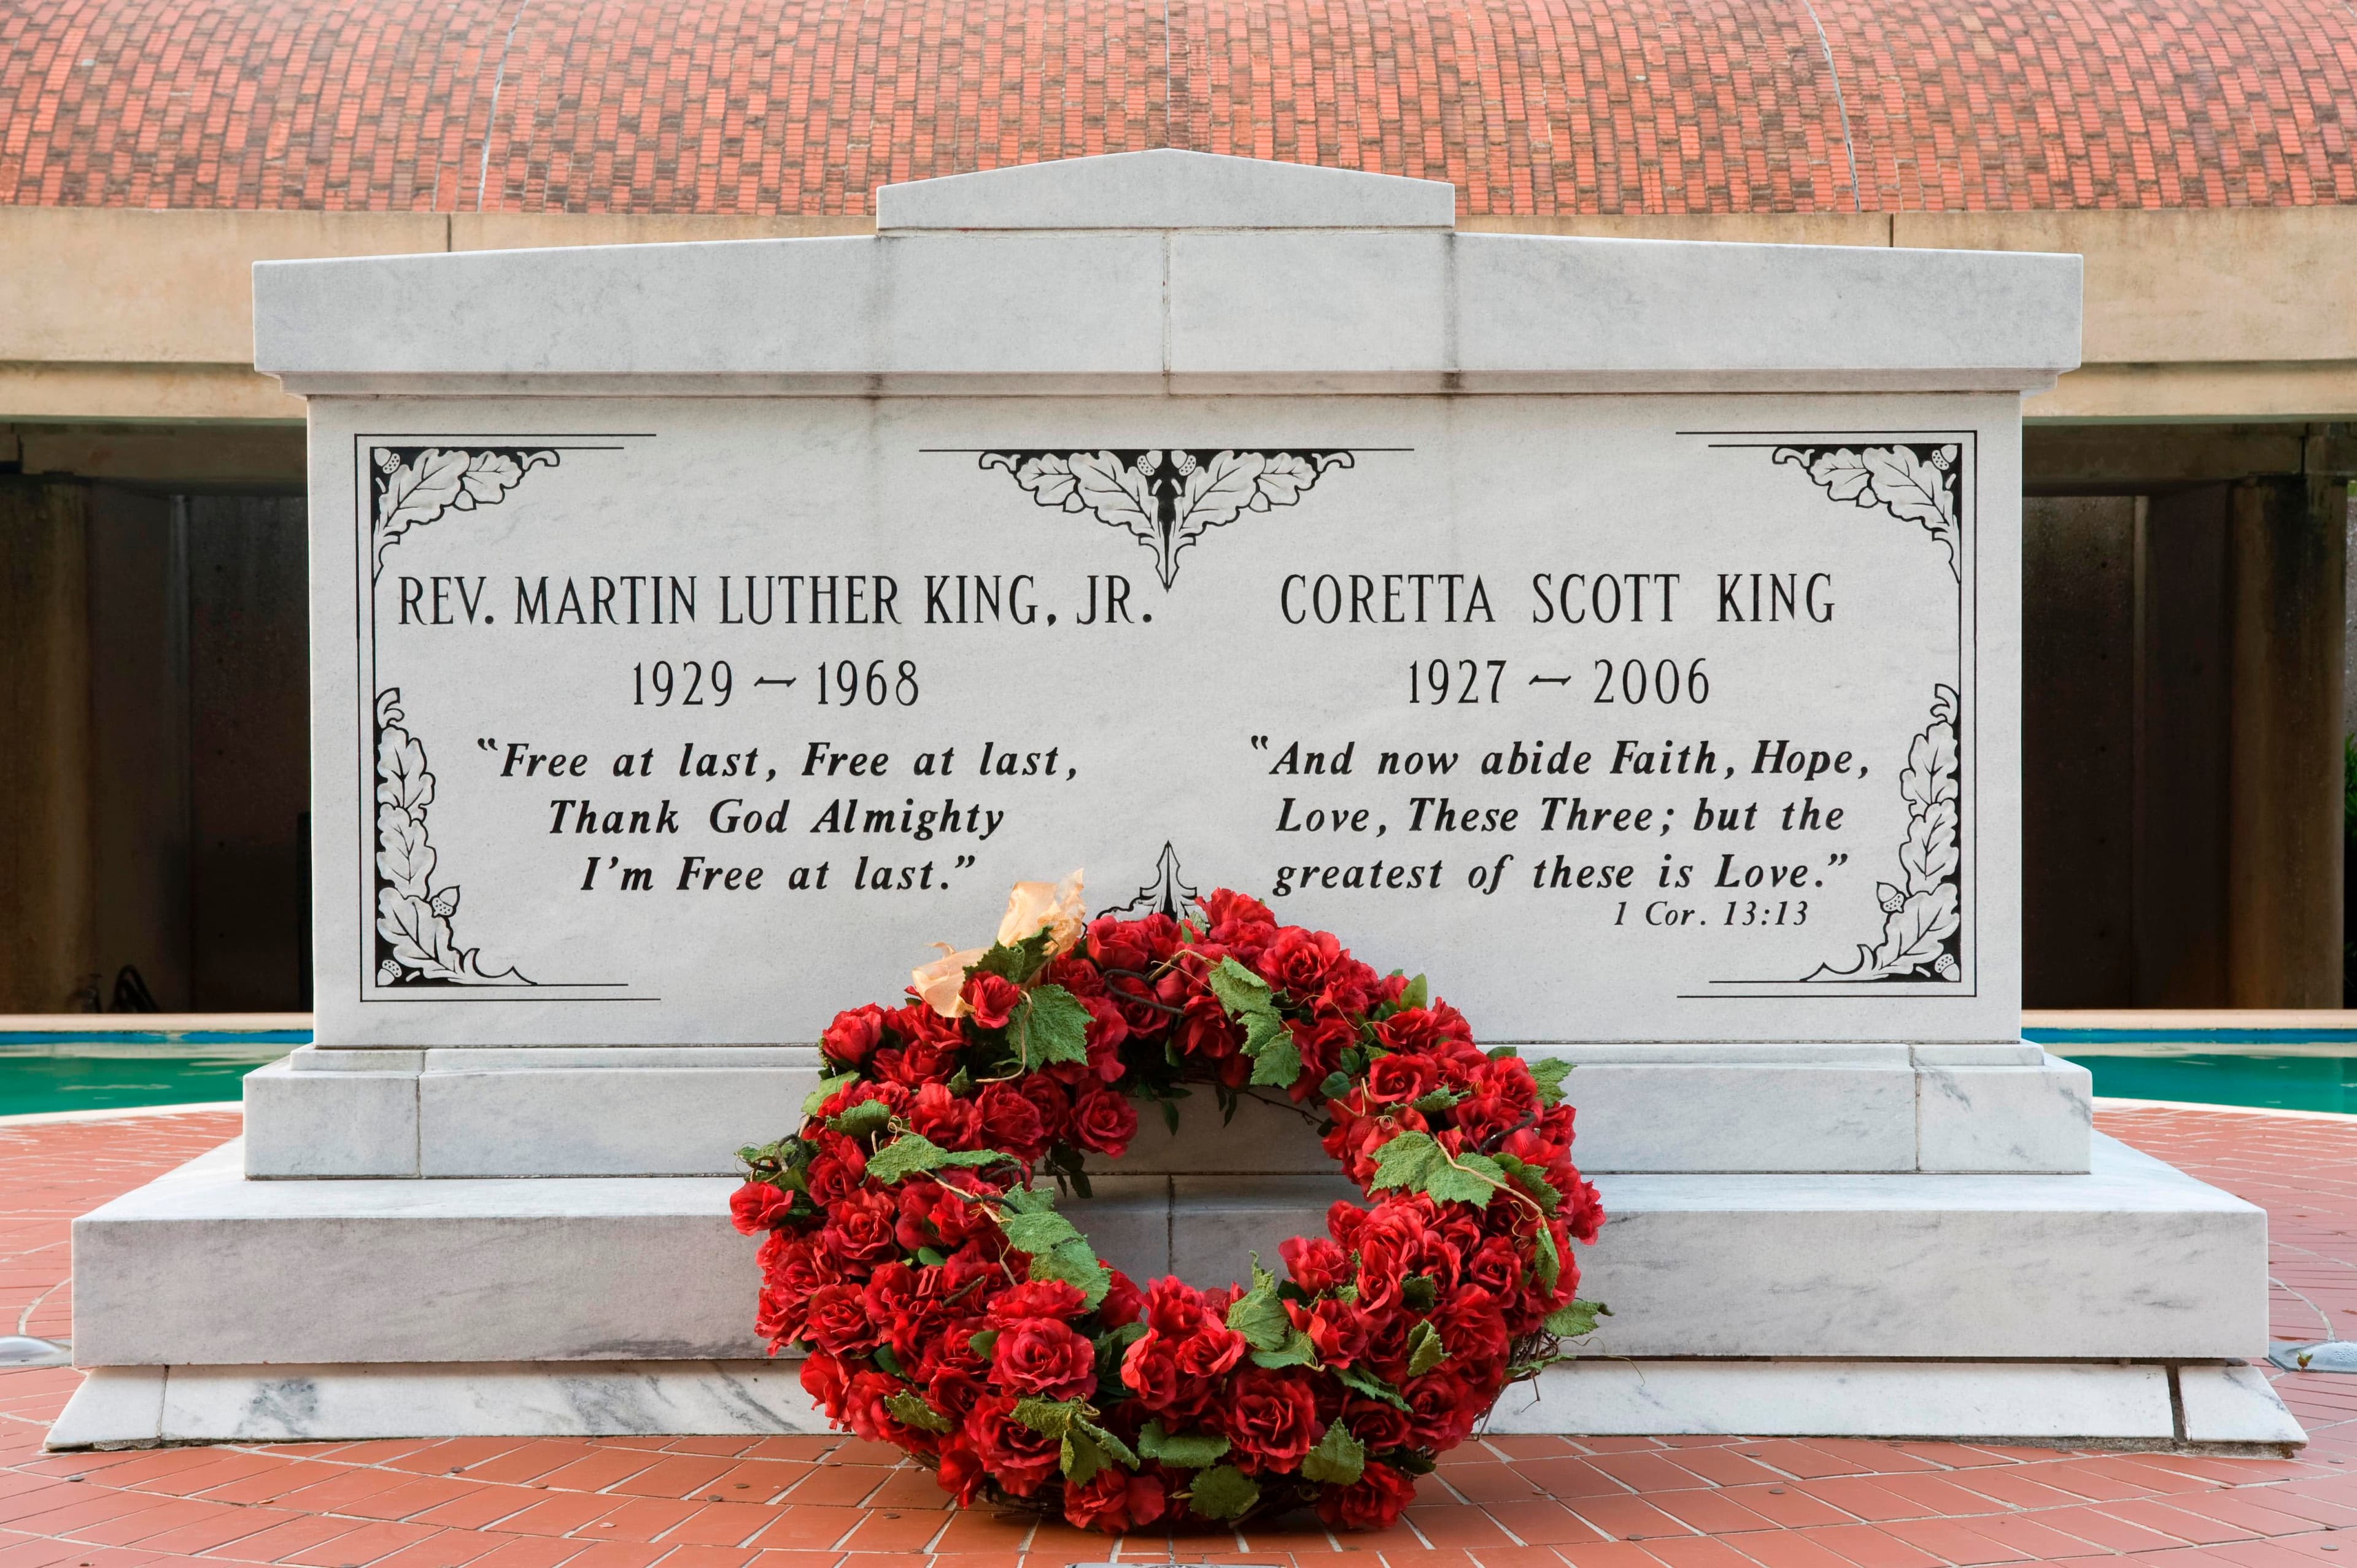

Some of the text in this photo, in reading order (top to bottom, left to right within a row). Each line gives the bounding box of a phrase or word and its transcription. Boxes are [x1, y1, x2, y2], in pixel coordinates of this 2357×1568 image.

[398, 574, 1152, 627] REV. MARTIN LUTHER KING, JR.
[1281, 573, 1835, 625] CORETTA SCOTT KING
[633, 660, 732, 707] 1929
[818, 659, 919, 707] 1968
[1409, 658, 1507, 705] 1927
[1593, 657, 1709, 705] 2006
[477, 738, 1077, 782] “Free at last, Free at last,
[1251, 735, 1868, 781] “And now abide Faith, Hope,
[549, 798, 1004, 841] Thank God Almighty
[1275, 797, 1844, 838] Love, These Three; but the
[580, 855, 975, 891] I’m Free at last.”
[1272, 853, 1848, 897] greatest of these is Love.”
[1614, 900, 1808, 926] 1 Cor. 13:13
